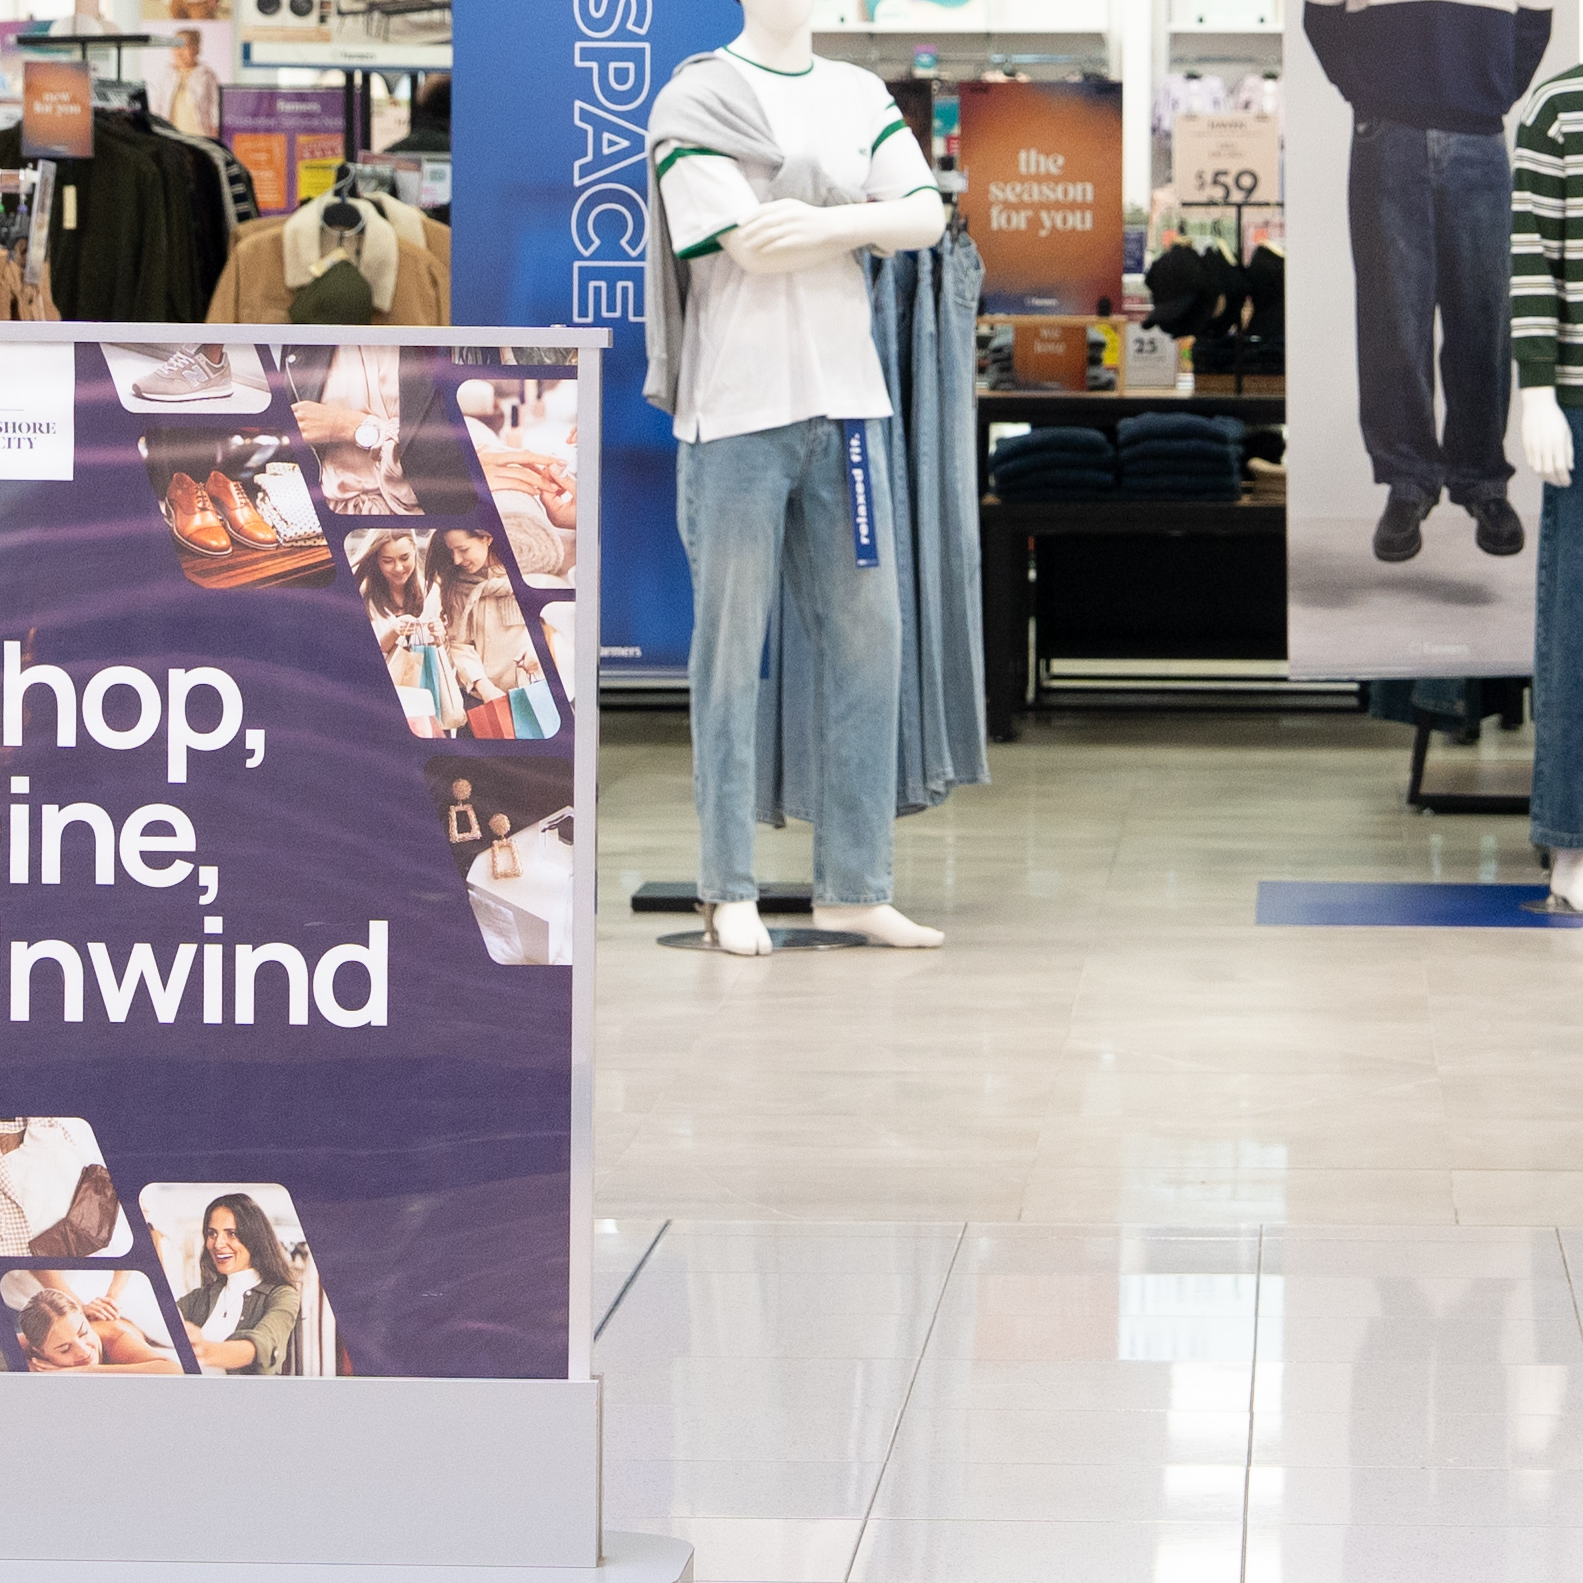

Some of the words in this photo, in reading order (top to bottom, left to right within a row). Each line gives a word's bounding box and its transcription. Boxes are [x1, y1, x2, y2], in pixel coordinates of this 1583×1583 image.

[1019, 148, 1066, 175] the
[989, 181, 1095, 204] season
[991, 204, 1033, 231] for
[1038, 209, 1095, 237] you
[851, 468, 870, 545] relaxed
